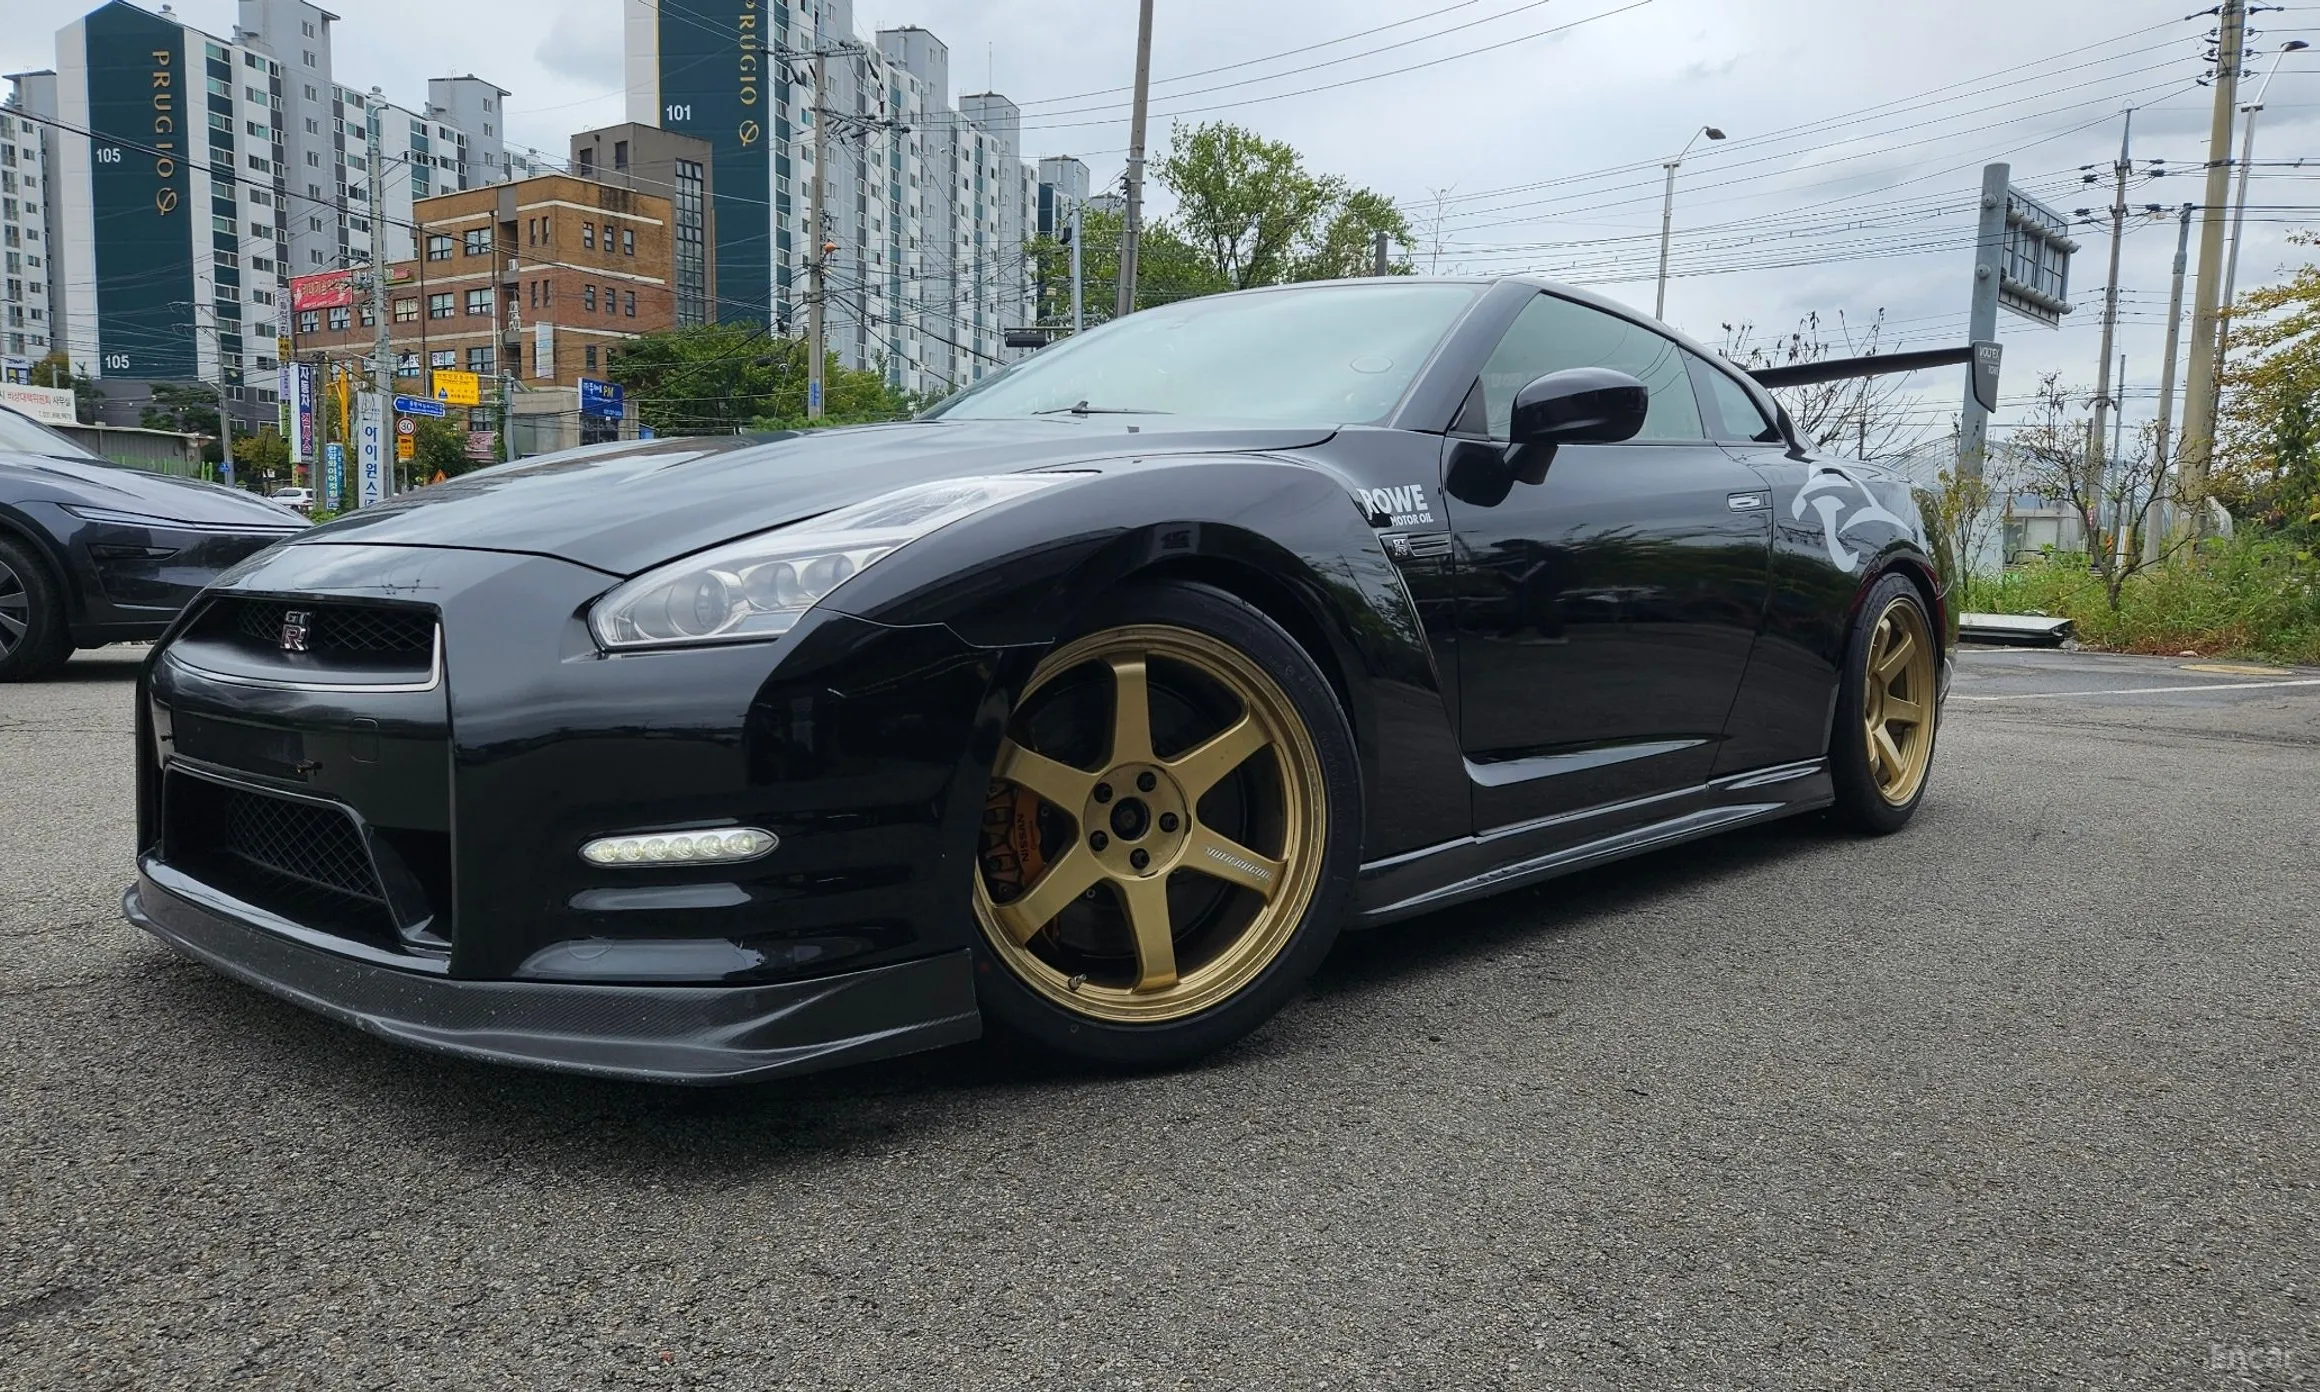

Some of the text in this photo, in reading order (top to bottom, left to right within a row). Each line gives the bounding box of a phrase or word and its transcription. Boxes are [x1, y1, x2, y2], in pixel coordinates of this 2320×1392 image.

[152, 51, 174, 178] PRUGIO
[666, 104, 691, 121] 101
[96, 148, 121, 163] 105
[105, 354, 130, 369] 105
[400, 422, 412, 431] 30
[1356, 484, 1429, 520] ROWE
[1390, 512, 1435, 527] MOTOR OIL
